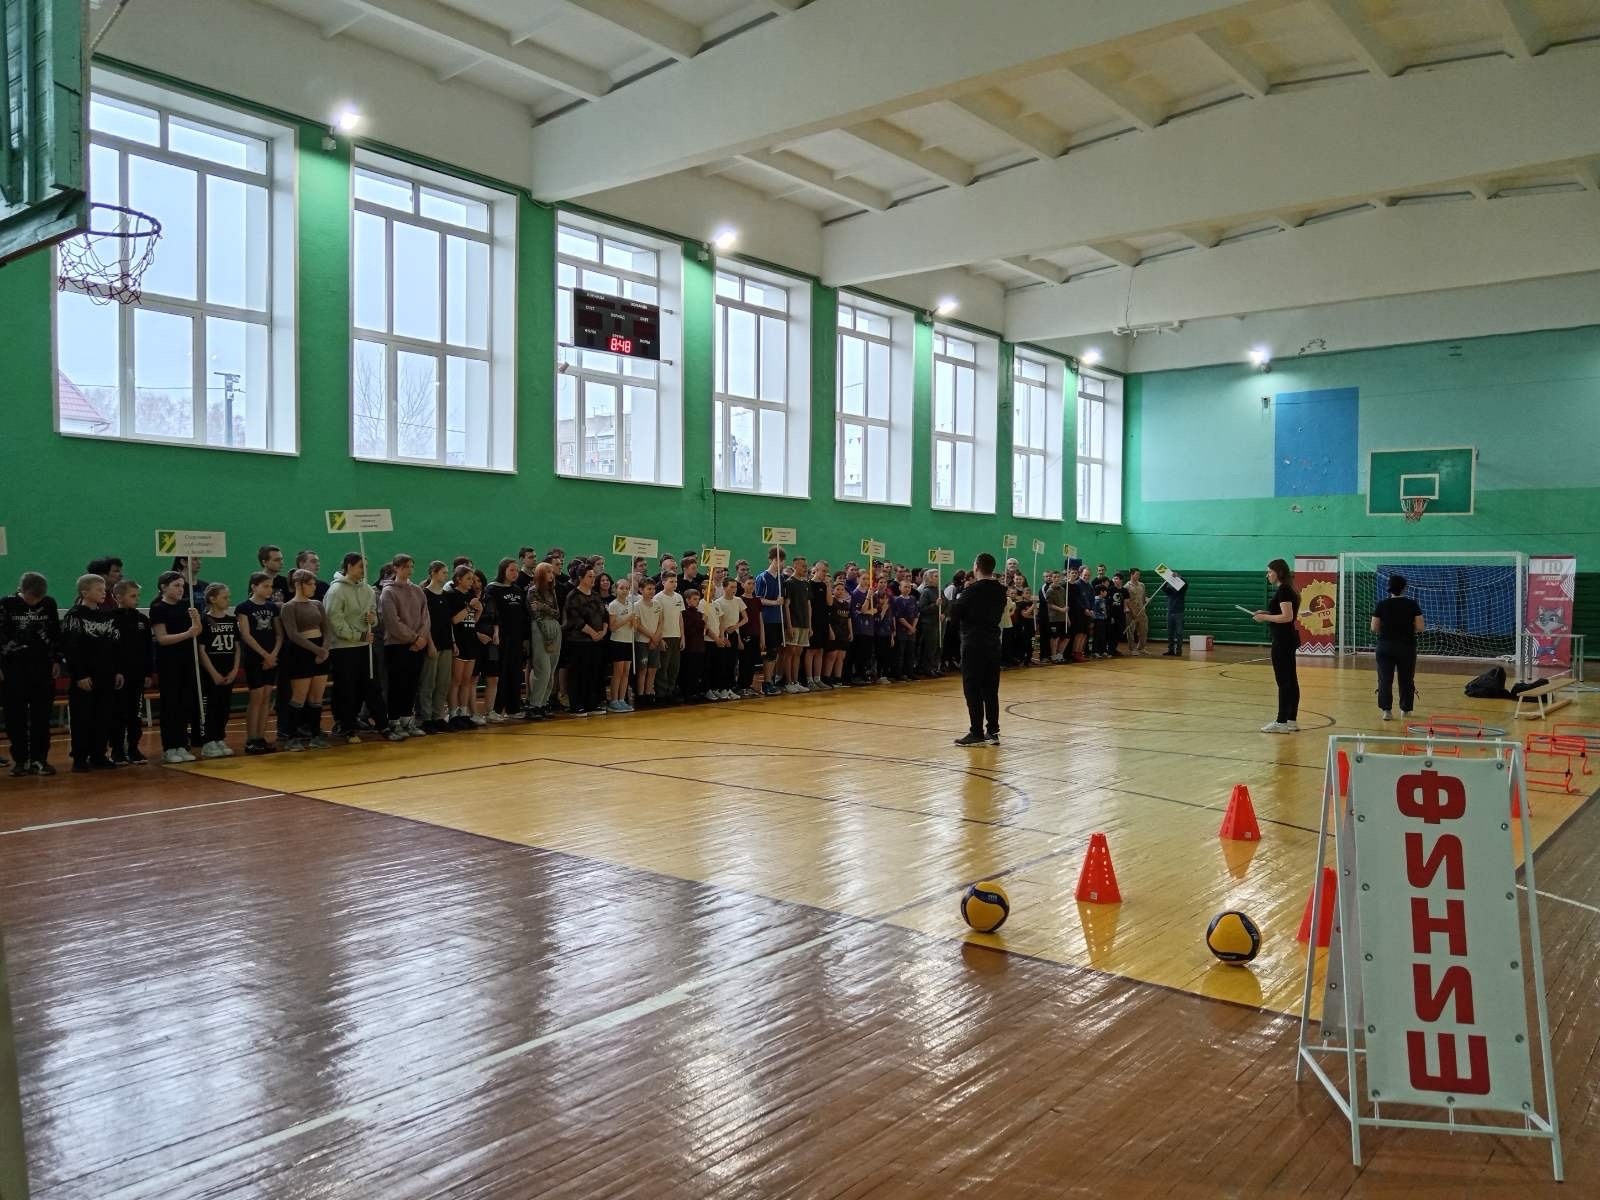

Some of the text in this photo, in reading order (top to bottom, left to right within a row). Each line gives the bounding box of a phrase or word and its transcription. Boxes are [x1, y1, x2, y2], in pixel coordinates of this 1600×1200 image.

[610, 338, 631, 353] 8:48
[1306, 560, 1326, 571] ГТО
[211, 624, 234, 632] HAPPY
[211, 634, 235, 651] 4U
[1396, 769, 1491, 1096] ФИНИШ
